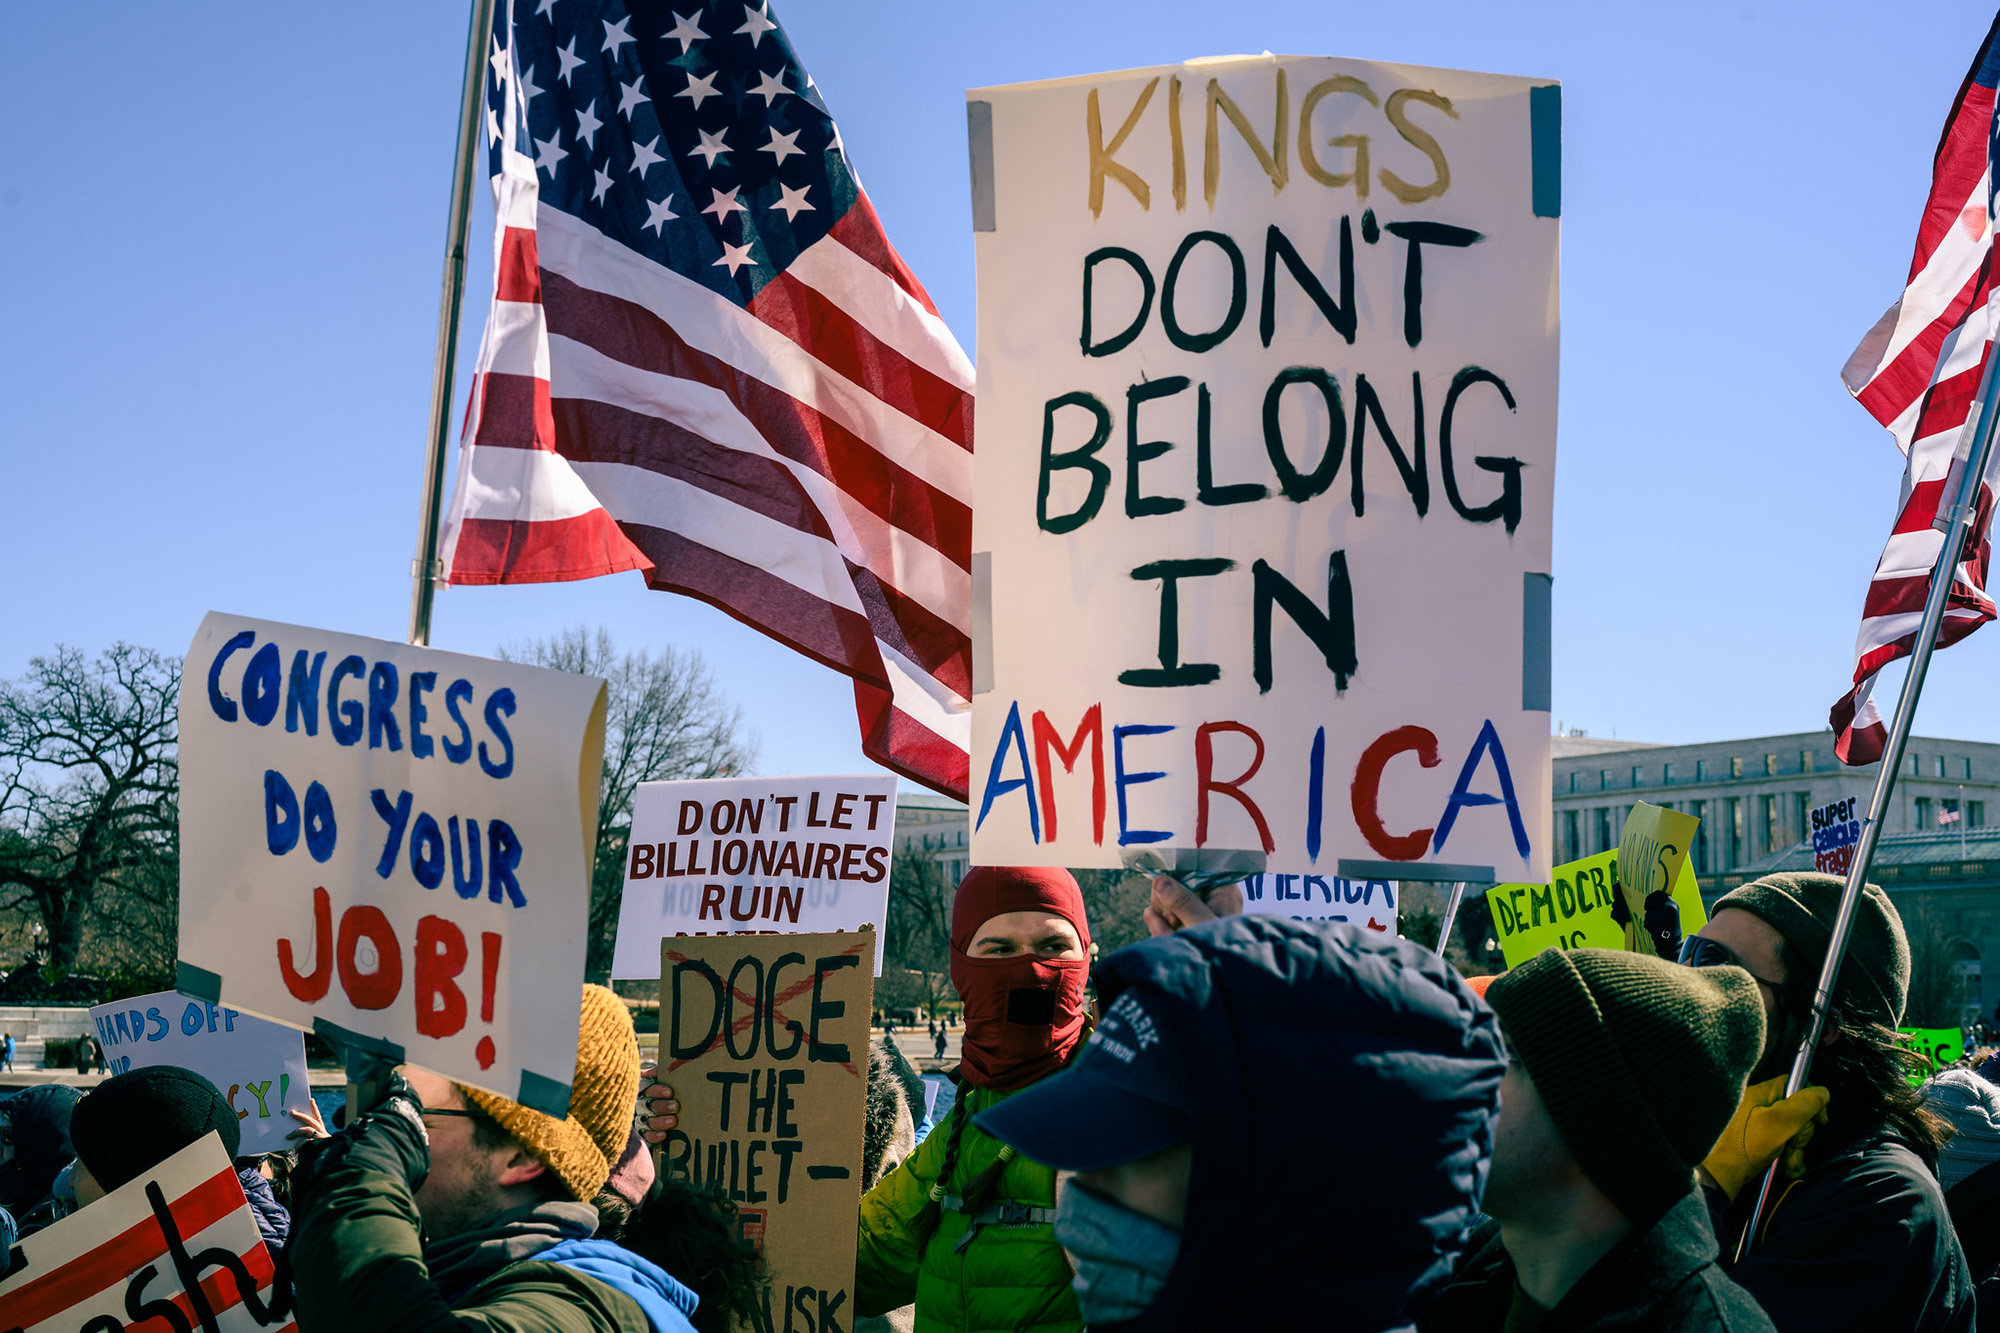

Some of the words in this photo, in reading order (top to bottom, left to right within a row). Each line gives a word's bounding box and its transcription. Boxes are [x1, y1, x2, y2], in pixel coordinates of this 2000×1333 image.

[1086, 67, 1461, 219] KINGS
[1080, 209, 1483, 358] DON'T
[1037, 366, 1526, 535] BELONG
[1118, 550, 1358, 694] IN
[208, 631, 517, 779] CONGRESS
[265, 770, 337, 863] DO
[371, 790, 527, 908] YOUR
[677, 793, 798, 836] DON'T
[806, 792, 887, 830] LET
[974, 700, 1531, 864] AMERICA
[1811, 796, 1856, 831] super
[629, 839, 889, 884] BILLIONAIRES
[698, 884, 804, 923] RUIN
[95, 1007, 170, 1047] HANDS
[277, 888, 502, 1071] JOB!
[670, 952, 860, 1063] DOGE
[706, 1067, 806, 1139] THE
